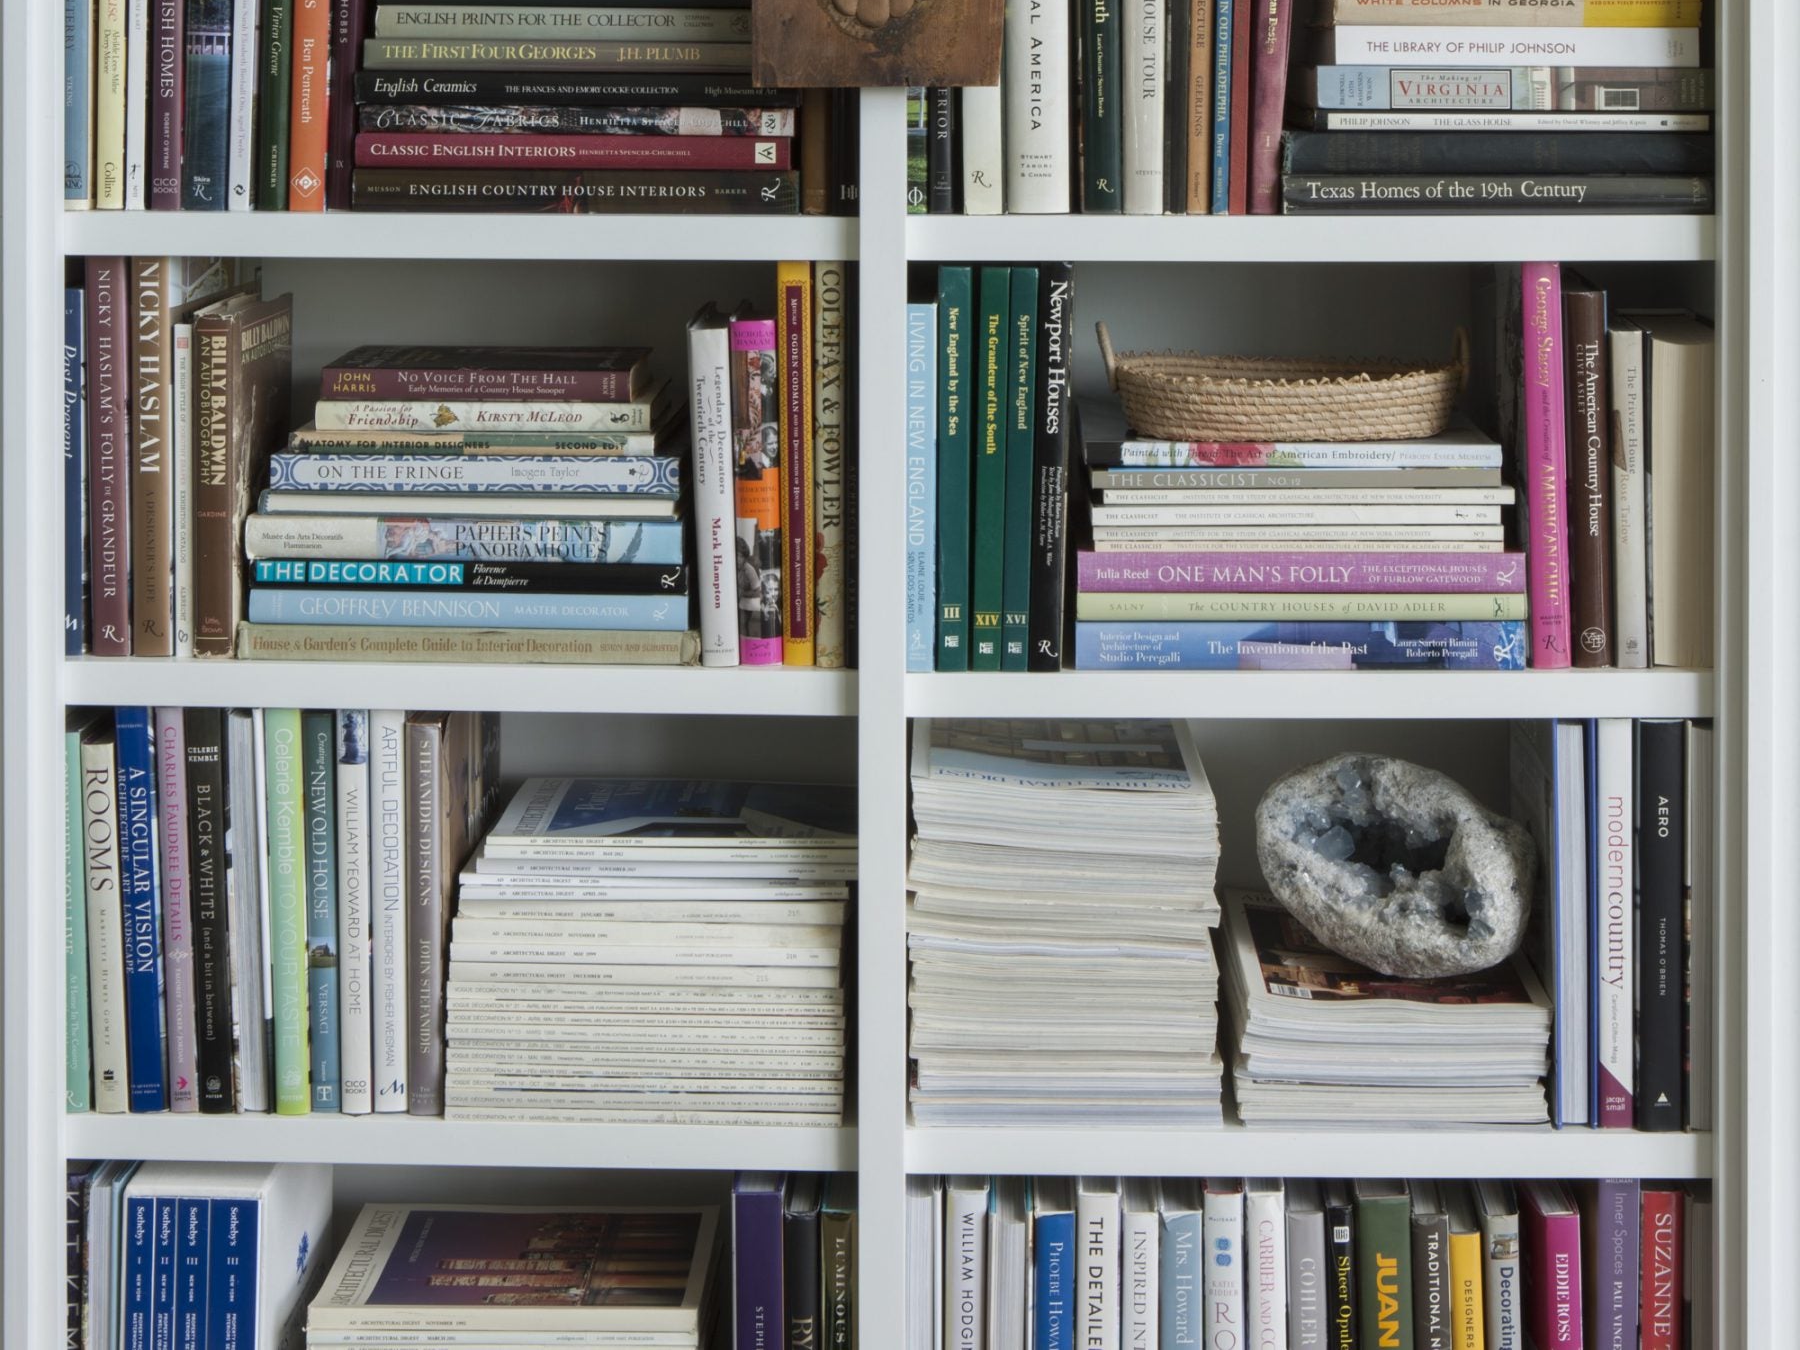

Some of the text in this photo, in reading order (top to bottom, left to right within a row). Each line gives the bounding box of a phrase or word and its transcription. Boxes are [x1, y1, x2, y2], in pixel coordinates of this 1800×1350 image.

[339, 0, 348, 44] HOBBS
[397, 12, 676, 27] ENGLISH PRINTS FOR THE COLLECTOR
[160, 36, 174, 98] HOMES
[303, 38, 314, 63] Ben
[1367, 41, 1576, 54] THE LIBRARY OF PHILIP JOHNSON
[302, 67, 314, 124] Pentreath
[1030, 36, 1042, 131] AMERICA
[1397, 80, 1504, 97] VIRGINIA
[409, 184, 706, 197] ENGLISH COUNTRY HOUSE INTERIORS
[1307, 181, 1587, 202] Texas Homes of the 19th Century
[139, 262, 160, 473] NICKY HASLAM
[339, 373, 371, 381] JOHN
[1045, 280, 1069, 435] Newport Houses
[211, 335, 227, 486] BILLY BALDWIN
[333, 383, 377, 392] HARRIS
[821, 269, 841, 530] COLEFAX & FOWLER
[1585, 341, 1601, 537] The American Country House
[317, 465, 464, 479] ON THE FRINGE
[262, 564, 461, 582] THE DECORATOR
[712, 518, 721, 609] Mark Hampton
[1158, 566, 1354, 583] ONE MAN'S FOLLY
[86, 768, 113, 891] ROOMS
[1658, 796, 1669, 838] AERO
[130, 768, 154, 973] A SINGULAR VISION
[1659, 917, 1667, 996] THOMAS O'BRIEN
[134, 1206, 145, 1246] Sotheby's
[160, 1206, 171, 1246] Sotheby's
[188, 1207, 198, 1247] Sotheby's
[228, 1207, 239, 1246] Sotheby's
[962, 1212, 975, 1281] WILLIAM
[1089, 1217, 1104, 1256] THE
[835, 1238, 846, 1344] LUMINOUS
[1176, 1231, 1193, 1344] Mrs. Howard
[1376, 1253, 1400, 1347] JUAN
[1556, 1253, 1570, 1342] EDDIE ROSS
[1654, 1213, 1673, 1337] SUZANNE
